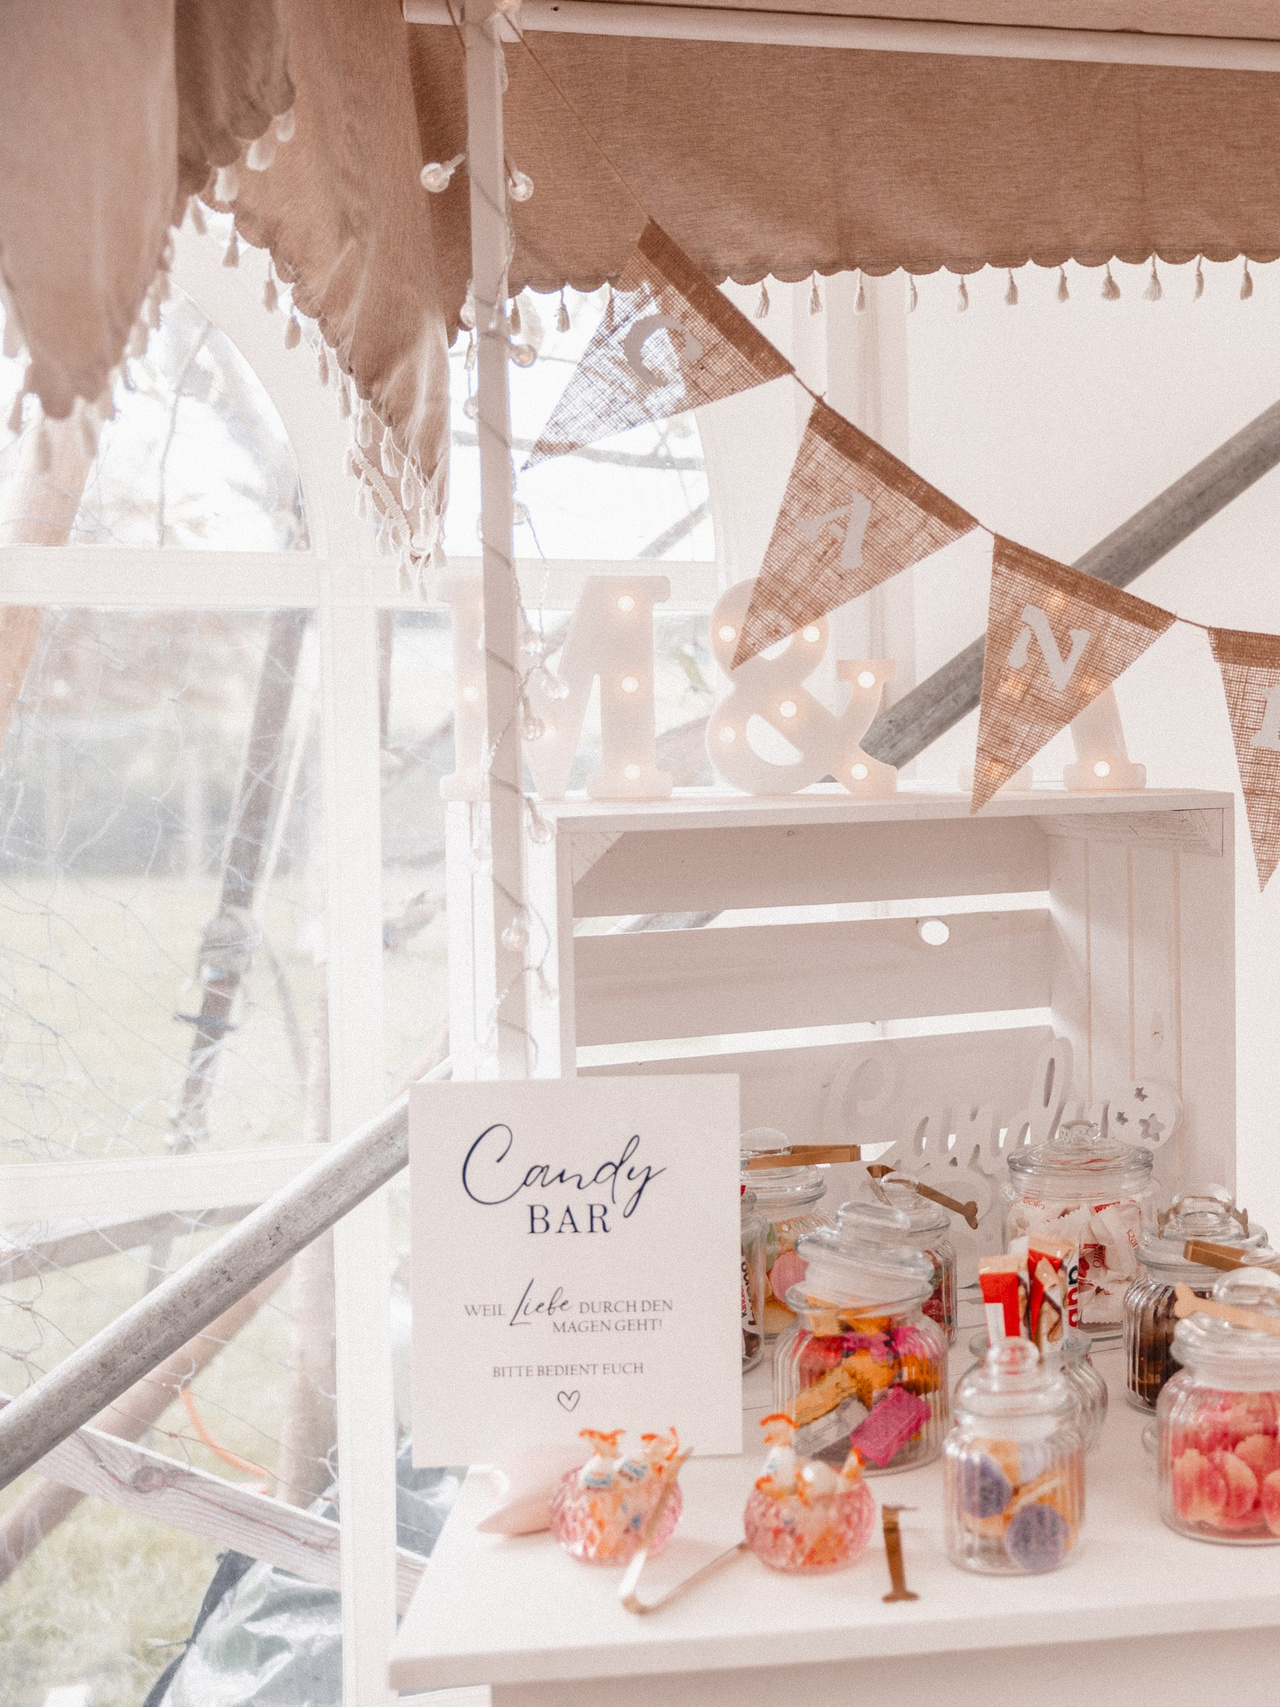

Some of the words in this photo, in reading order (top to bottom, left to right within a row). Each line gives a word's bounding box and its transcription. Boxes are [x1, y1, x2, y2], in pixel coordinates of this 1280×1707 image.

[461, 1123, 668, 1219] Candy
[526, 1202, 613, 1235] BAR
[464, 1302, 507, 1317] WEIL
[508, 1278, 573, 1327] Liebe
[579, 1300, 640, 1314] DURCH
[641, 1299, 674, 1313] DEN
[552, 1319, 612, 1334] MAGEN
[614, 1318, 663, 1333] GEHT!
[492, 1365, 534, 1378] BITTE
[536, 1363, 599, 1378] BEDIENT
[601, 1361, 645, 1376] EUCH
